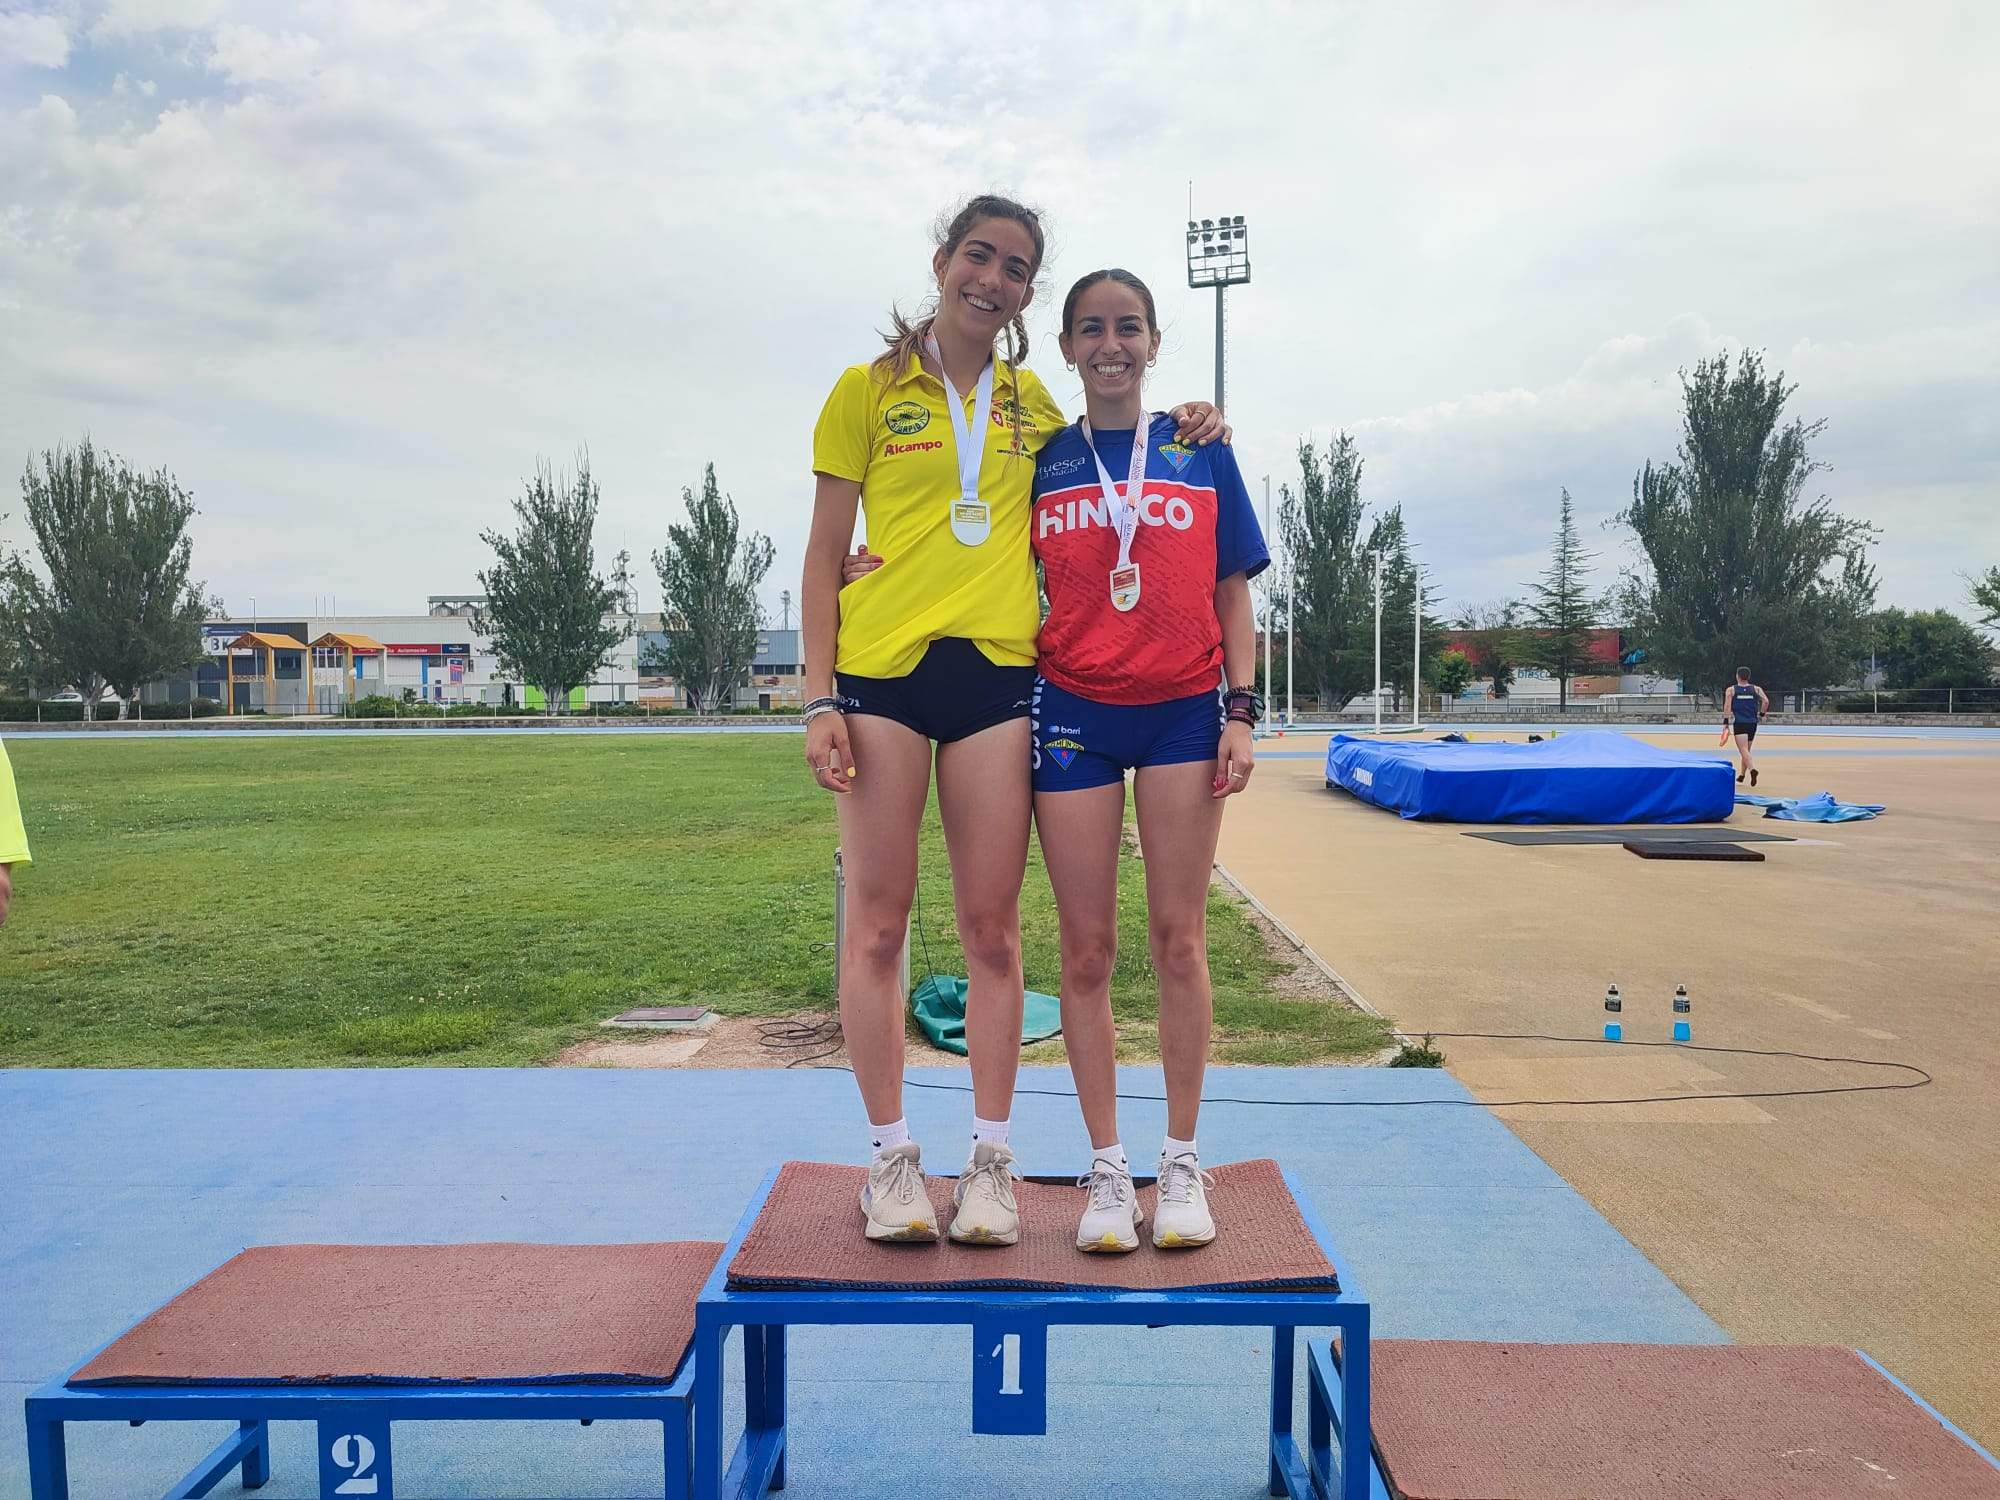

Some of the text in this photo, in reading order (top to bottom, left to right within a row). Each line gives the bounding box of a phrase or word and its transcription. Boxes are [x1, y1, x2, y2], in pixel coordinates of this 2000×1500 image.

[884, 440, 943, 458] Alcampo
[1039, 494, 1194, 539] HINCO
[991, 1333, 1024, 1395] 1
[331, 1434, 379, 1495] 2
